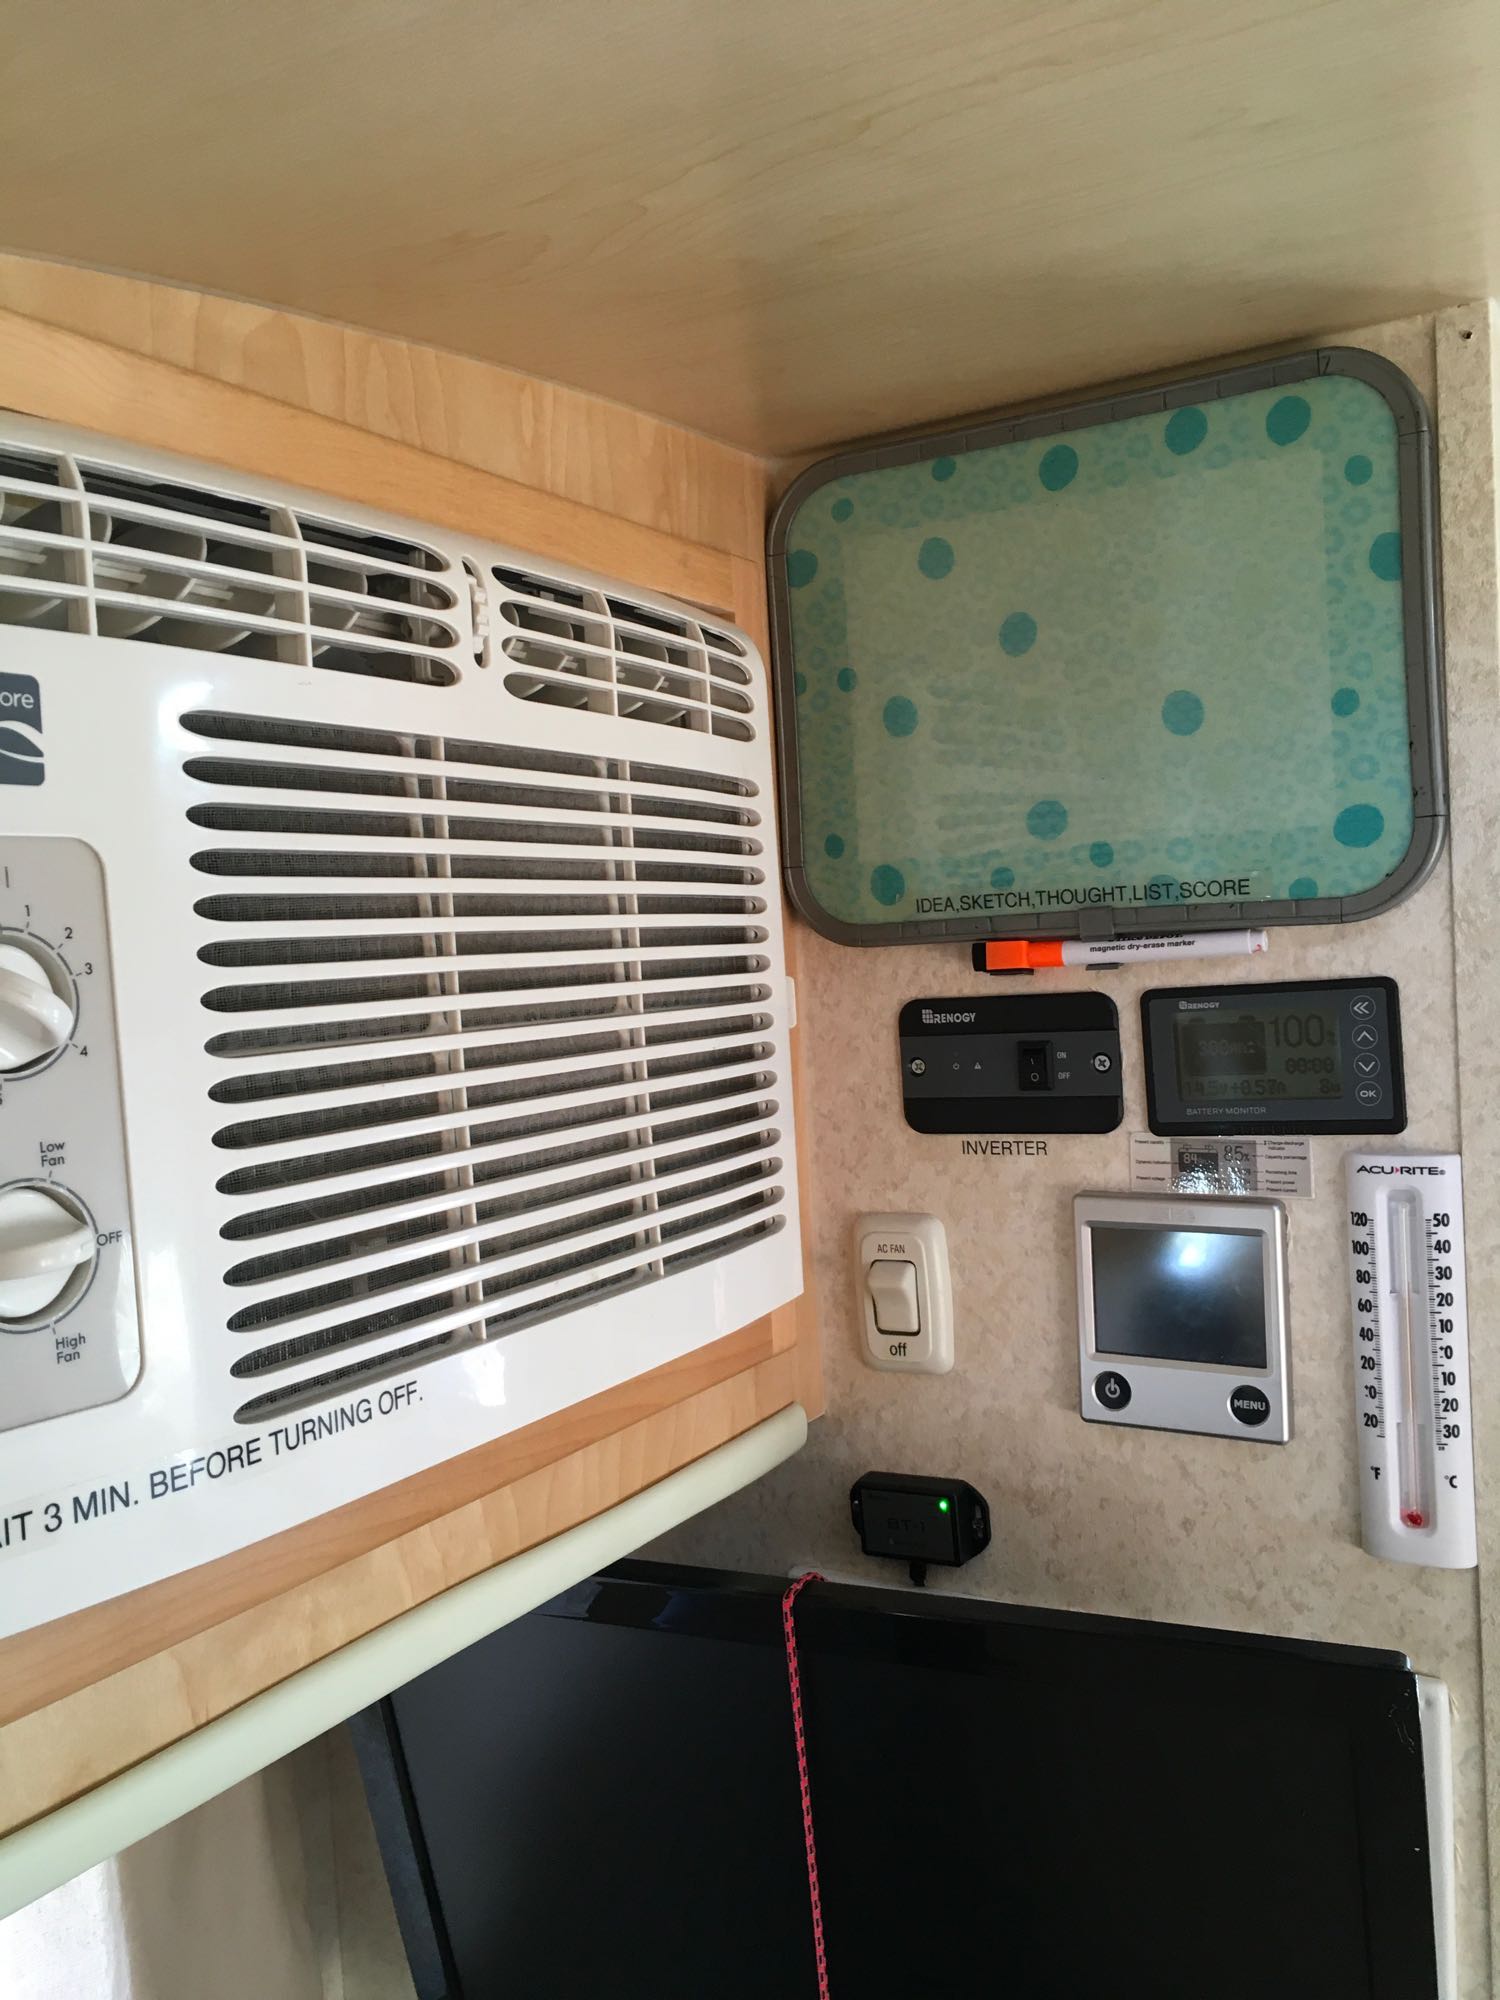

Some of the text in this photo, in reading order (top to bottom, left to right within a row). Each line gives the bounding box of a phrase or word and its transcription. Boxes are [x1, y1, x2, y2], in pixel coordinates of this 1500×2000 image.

[0, 691, 34, 709] ore
[25, 905, 31, 917] 1
[64, 926, 73, 940] 2
[1089, 939, 1196, 953] magnetic dry-erase marker
[85, 962, 93, 976] 3
[1187, 1001, 1220, 1010] RENOGY
[934, 1012, 976, 1024] RENOGY
[79, 1045, 89, 1058] 4
[1057, 1051, 1067, 1060] ON
[1058, 1072, 1071, 1080] OFF
[1359, 1089, 1377, 1098] OK
[1186, 1106, 1267, 1116] BATTERY MONITOR
[39, 1141, 65, 1154] Low
[961, 1140, 1048, 1156] INVERTER
[41, 1155, 65, 1168] Fan
[1351, 1211, 1368, 1227] 120
[1432, 1213, 1450, 1227] 50
[97, 1230, 123, 1246] OFF
[877, 1243, 905, 1254] AC FAN
[1352, 1240, 1369, 1255] 100
[1434, 1239, 1451, 1254] 40
[1356, 1270, 1371, 1284] 80
[1435, 1265, 1453, 1281] 30
[1357, 1298, 1373, 1313] 60
[1436, 1292, 1454, 1307] 20
[1439, 1318, 1454, 1333] 10
[55, 1332, 86, 1351] High
[1359, 1327, 1374, 1342] 40
[889, 1342, 907, 1356] off
[56, 1351, 81, 1364] Fan
[1360, 1355, 1376, 1371] 20
[1441, 1371, 1456, 1386] 10
[1233, 1398, 1266, 1411] MENU
[1441, 1398, 1459, 1413] 20
[1363, 1413, 1379, 1429] 20
[1443, 1424, 1460, 1439] 30
[0, 1380, 424, 1548] IT 3 MIN. BEFORE TURNING OFF.
